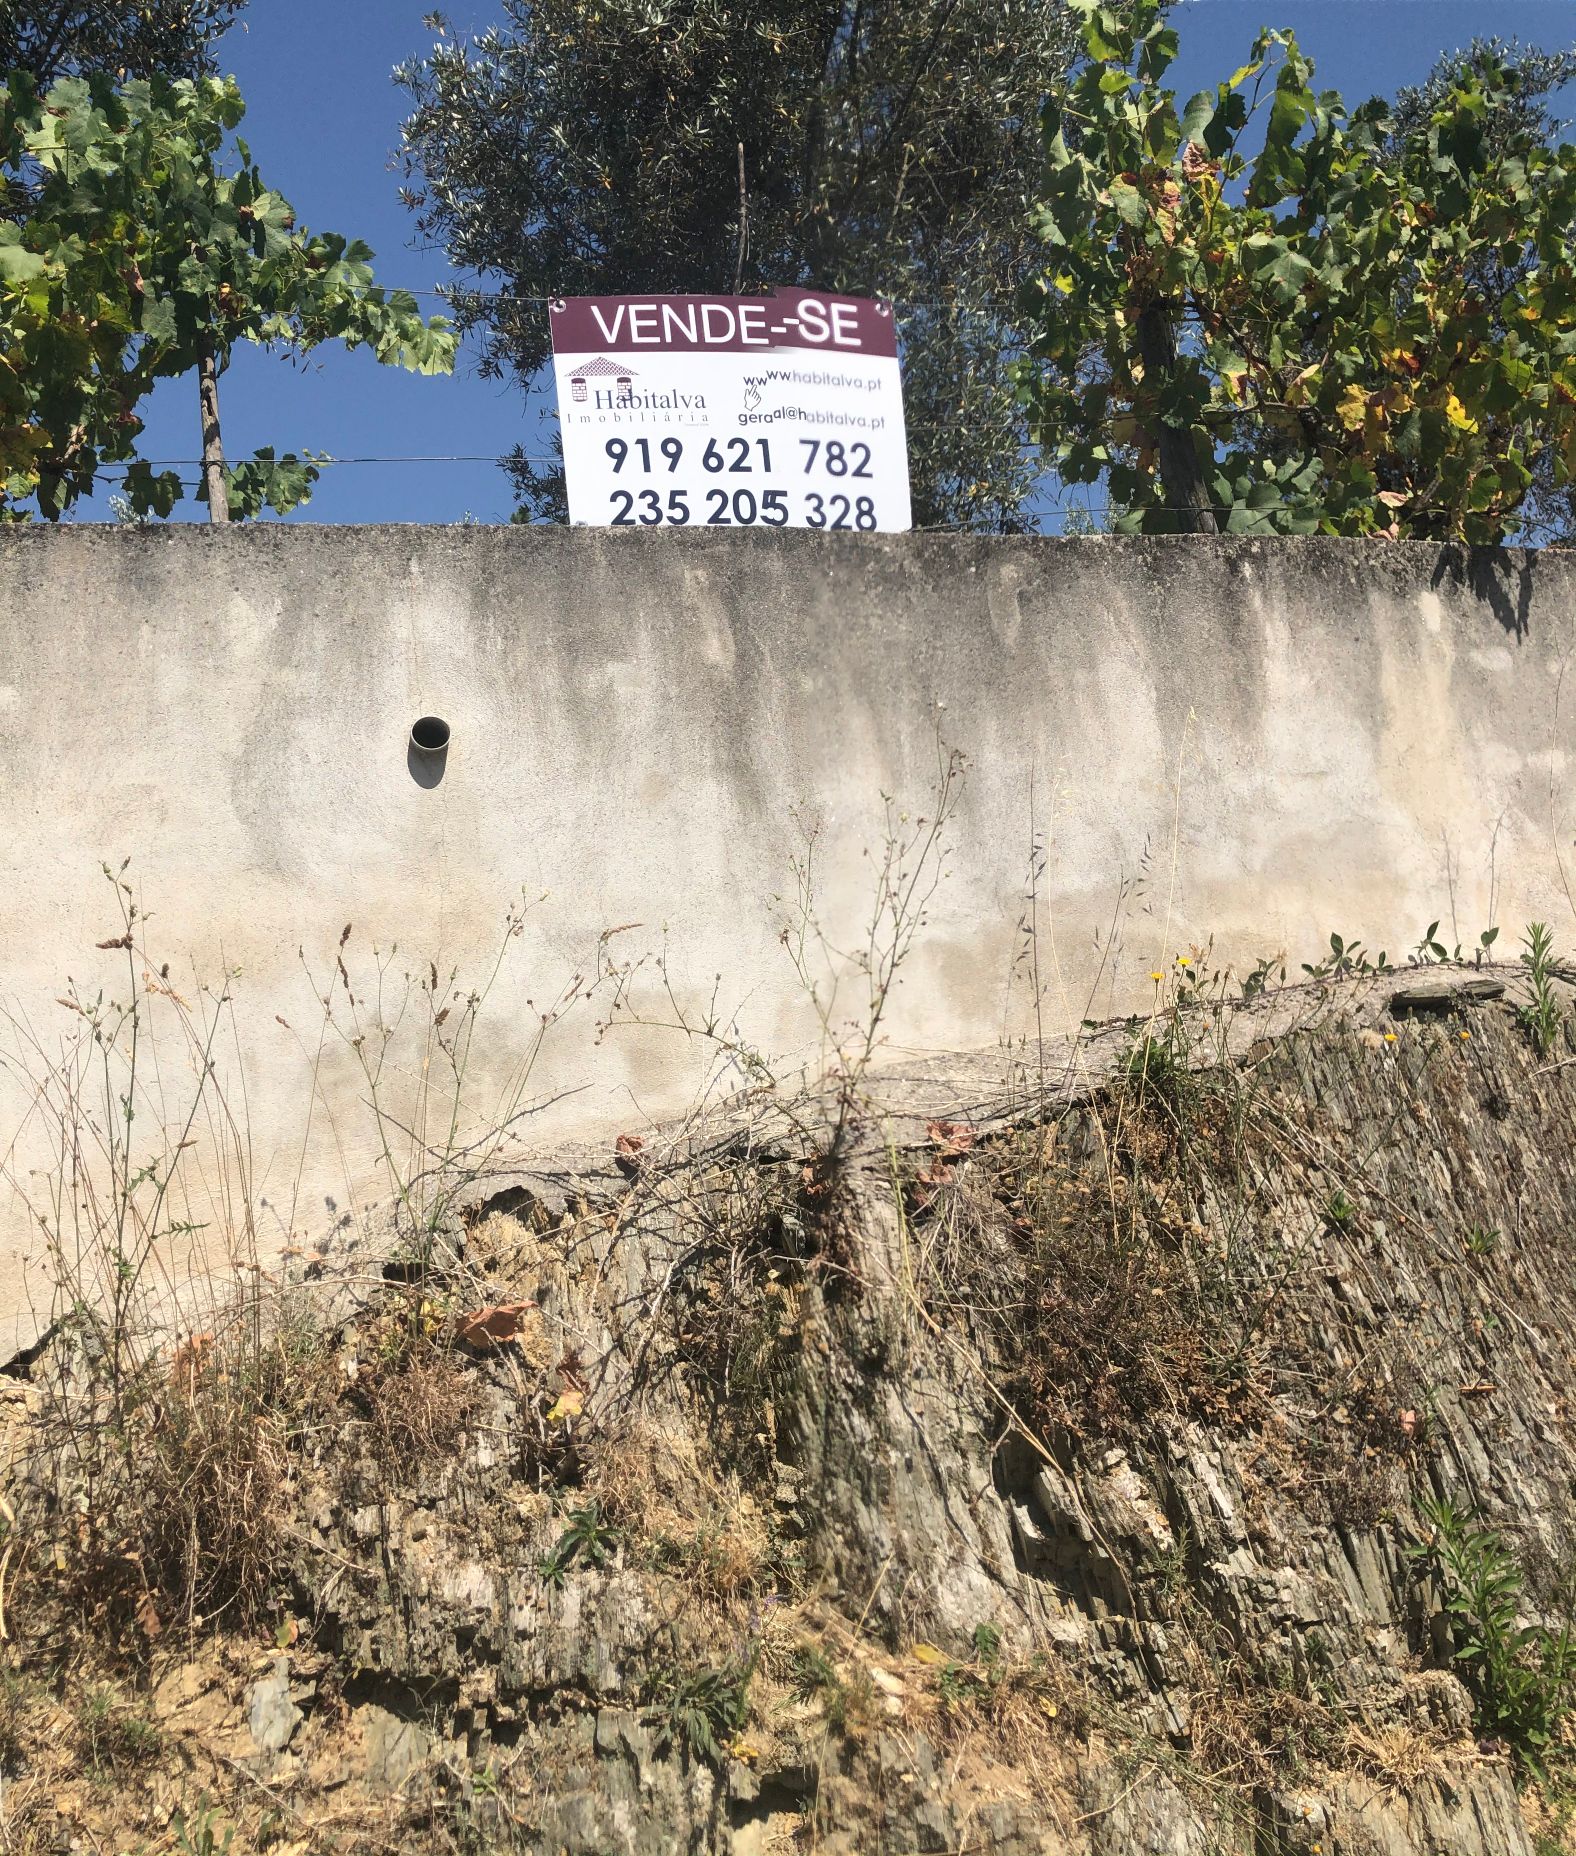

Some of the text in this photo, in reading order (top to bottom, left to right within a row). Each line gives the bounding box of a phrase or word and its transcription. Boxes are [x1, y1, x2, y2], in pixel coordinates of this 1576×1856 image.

[594, 388, 707, 410] Habitalva
[567, 411, 710, 424] Imobiliária
[605, 437, 873, 478] 919 621 782
[609, 488, 877, 531] 235 205 328
